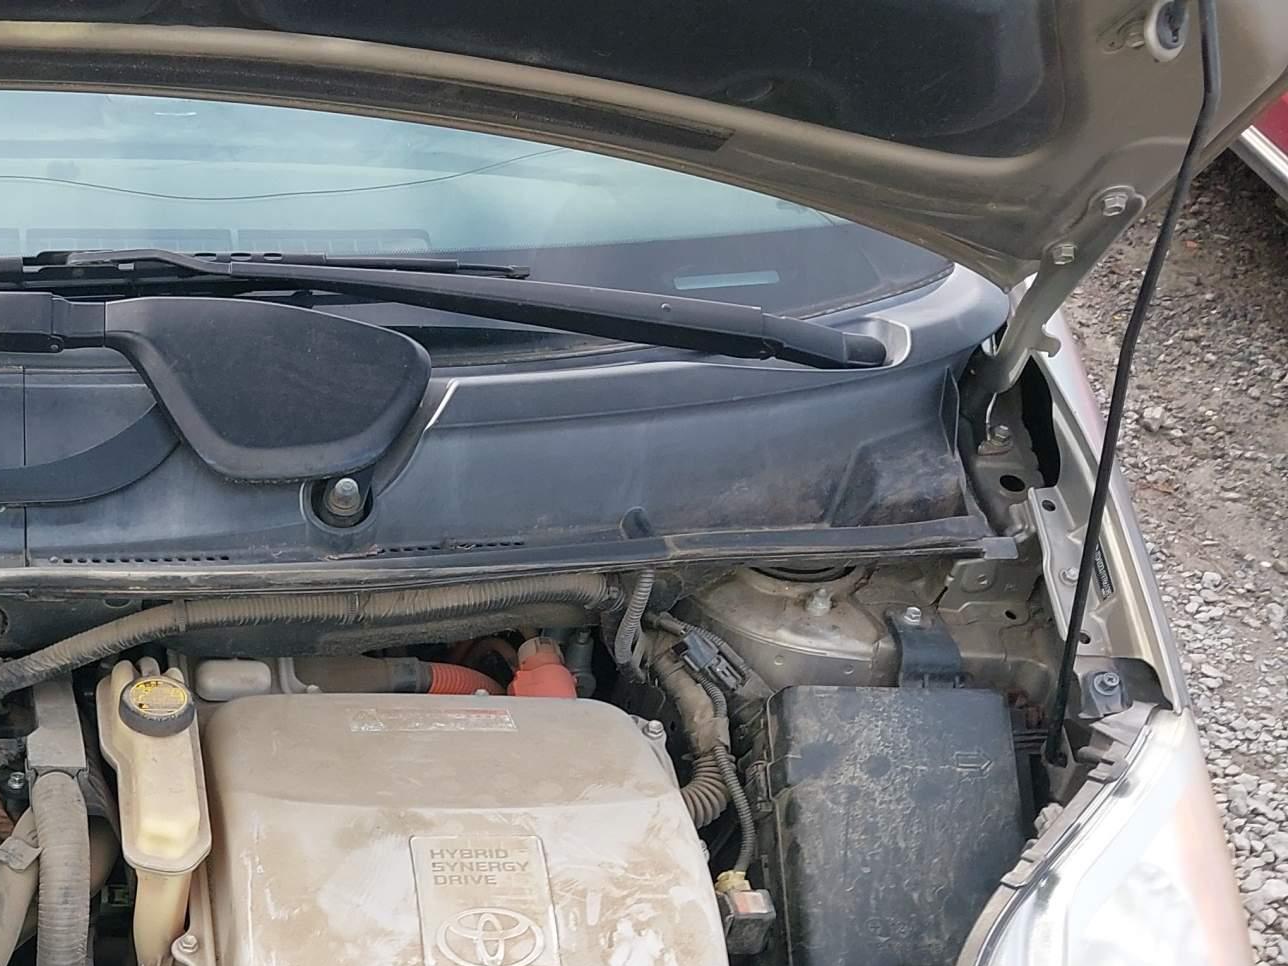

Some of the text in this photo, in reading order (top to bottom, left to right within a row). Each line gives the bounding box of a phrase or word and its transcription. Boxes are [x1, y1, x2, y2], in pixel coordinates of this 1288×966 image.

[430, 848, 509, 860] HYBRID
[431, 861, 529, 873] SYNERGY
[433, 874, 497, 886] DRIVE
